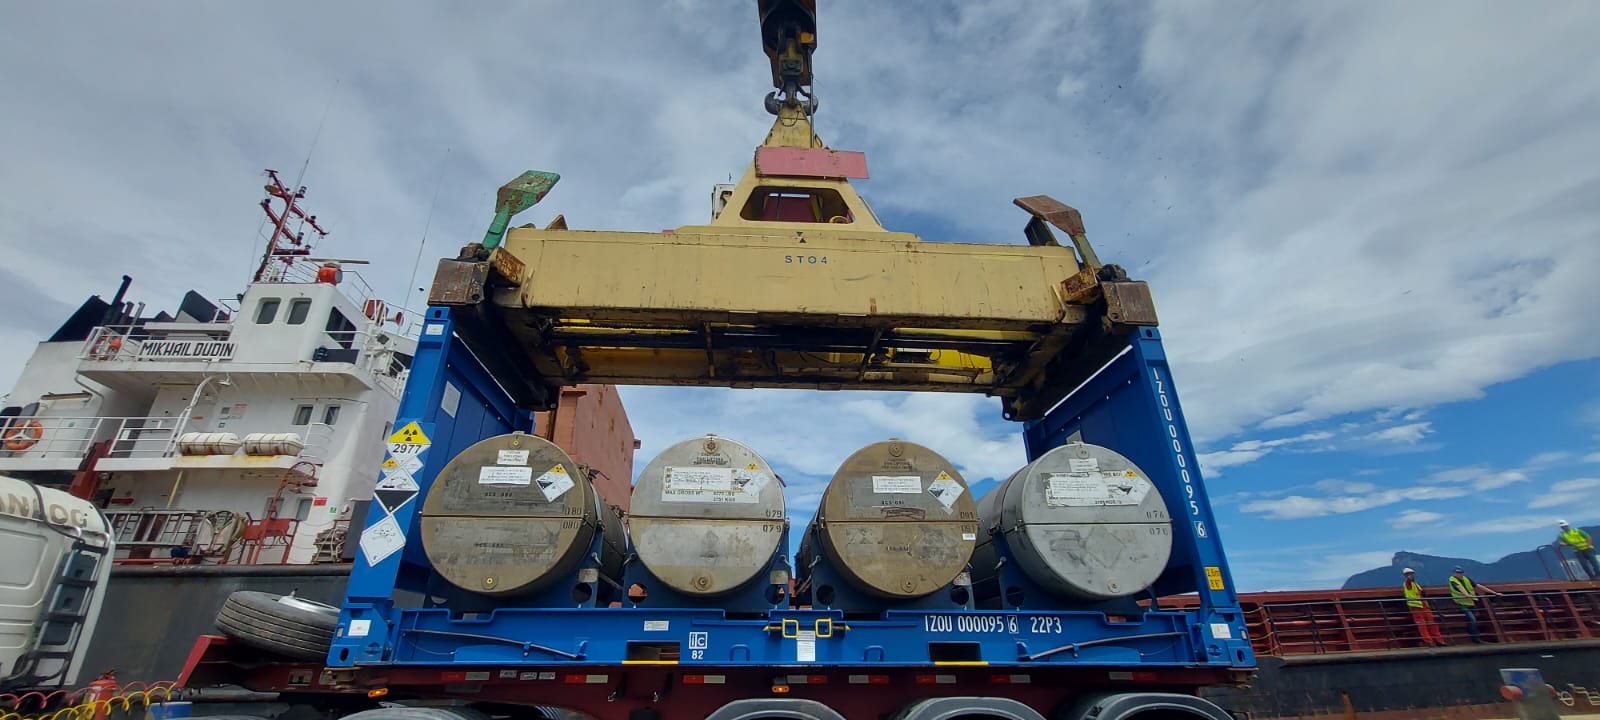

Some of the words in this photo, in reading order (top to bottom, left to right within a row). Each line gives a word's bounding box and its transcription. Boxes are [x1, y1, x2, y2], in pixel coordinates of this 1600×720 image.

[140, 342, 192, 356] MIKHAIL
[192, 342, 235, 357] DUDIN
[392, 443, 422, 455] 2977
[765, 509, 783, 518] 079
[762, 524, 782, 533] 079
[957, 616, 1004, 633] 000095
[1030, 616, 1062, 634] 22P3
[691, 650, 704, 660] 82
